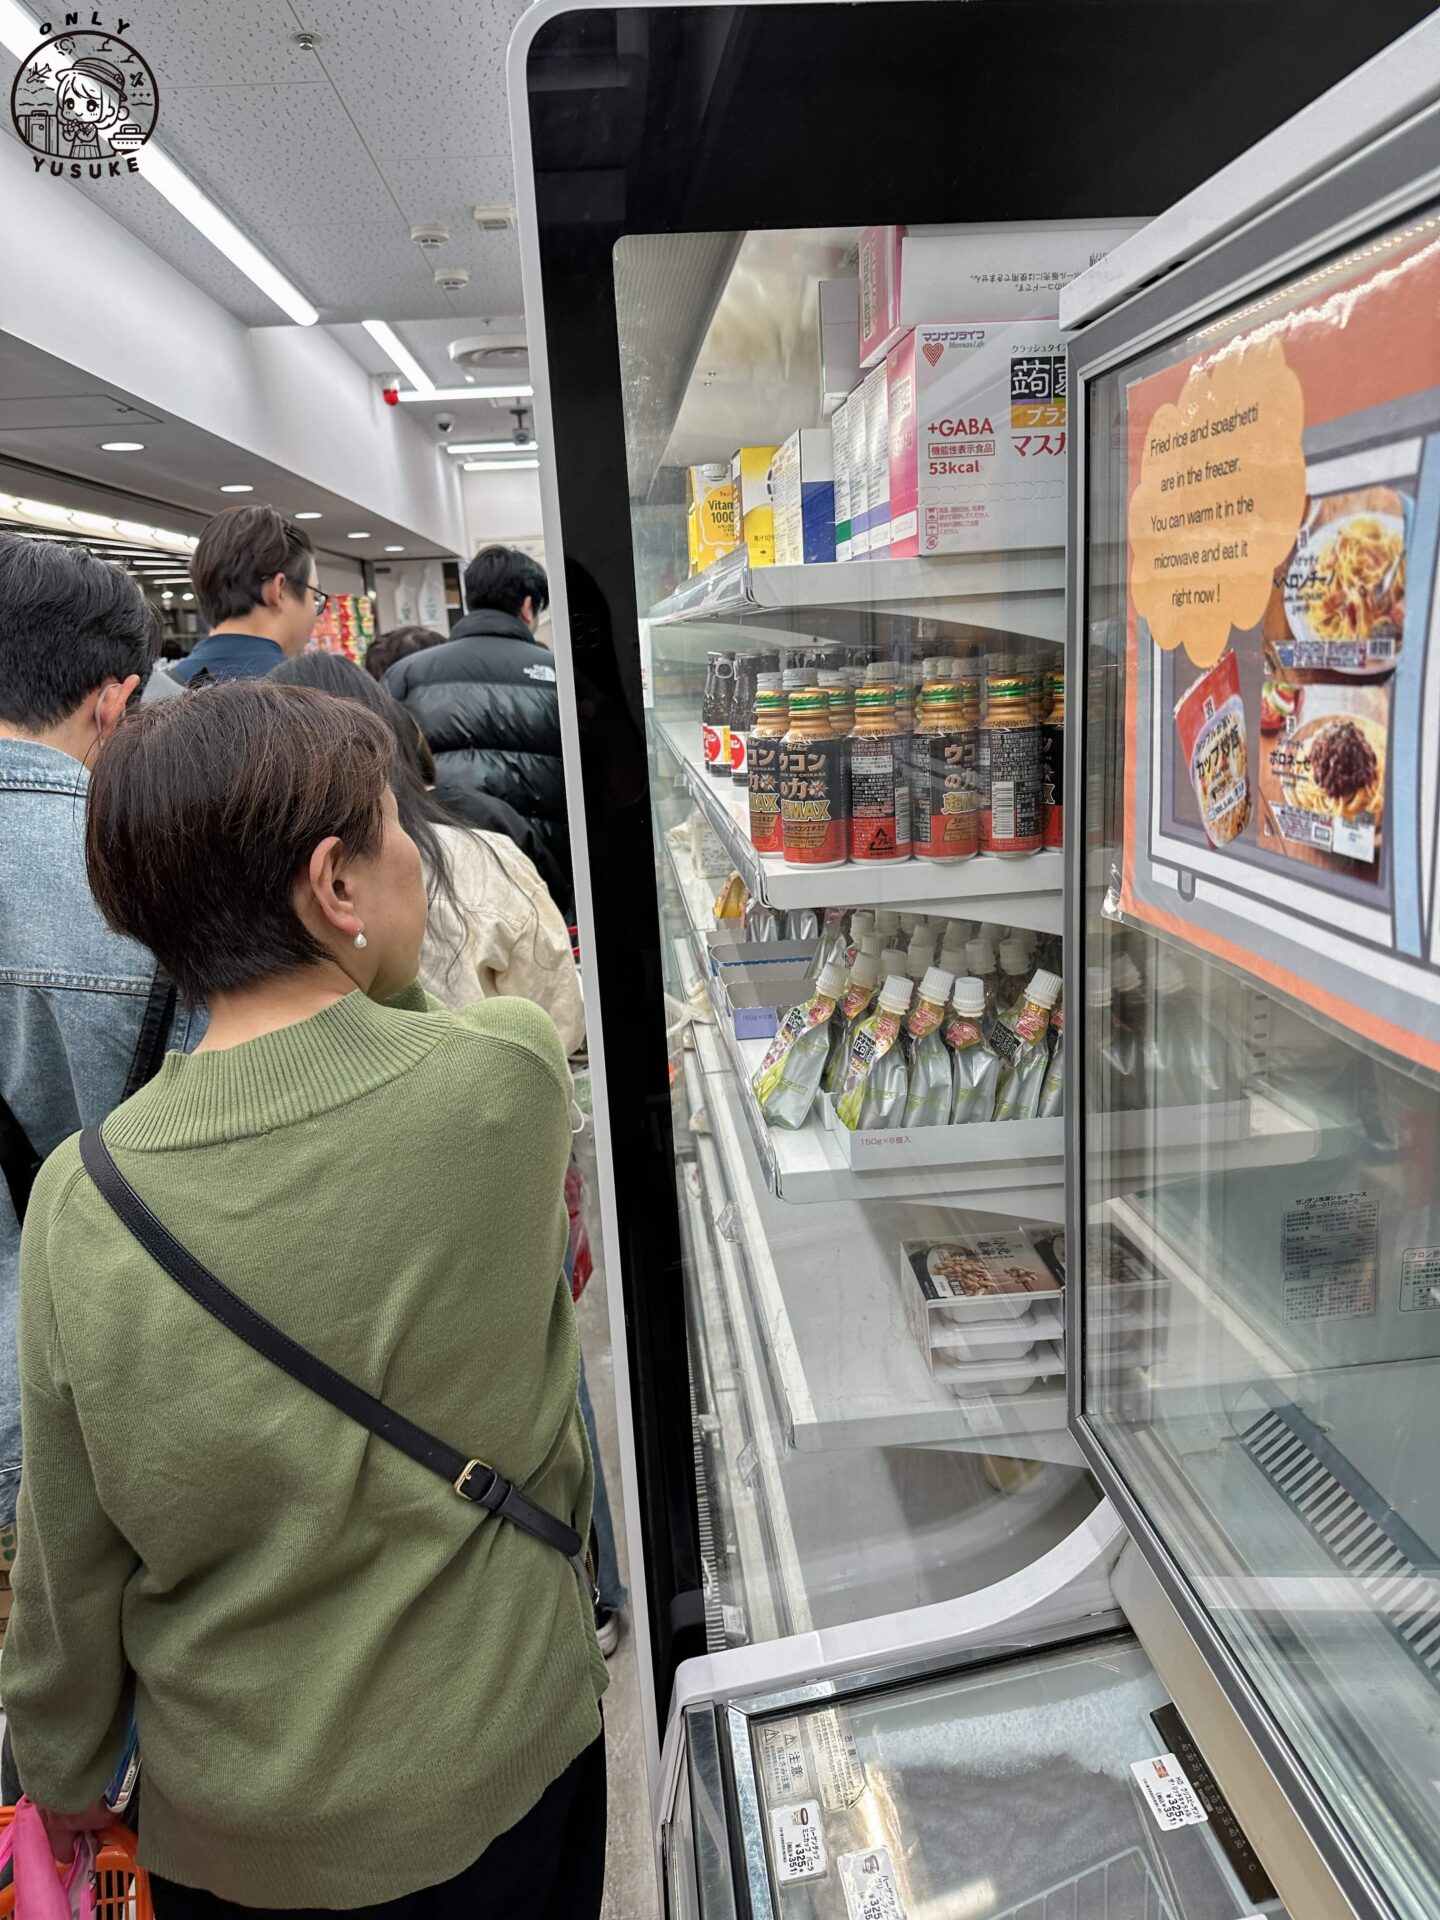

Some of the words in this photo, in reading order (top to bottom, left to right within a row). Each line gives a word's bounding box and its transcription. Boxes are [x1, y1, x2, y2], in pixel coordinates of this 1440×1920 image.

[922, 330, 985, 342] マンナンライフ
[928, 417, 994, 437] +GABA
[1150, 433, 1171, 457] Fried
[1172, 432, 1188, 450] rice
[1190, 420, 1209, 444] and
[1211, 401, 1260, 436] spaghetti
[931, 443, 993, 456] 機能性表示食品
[929, 460, 979, 475] 53kcal
[1161, 477, 1175, 492] are
[1176, 472, 1185, 488] in
[1187, 466, 1202, 485] the
[1205, 458, 1242, 480] freezer.
[1151, 515, 1167, 532] You
[1169, 513, 1185, 529] can
[1187, 507, 1213, 525] warm
[1215, 502, 1222, 519] it
[1224, 500, 1234, 518] in
[1237, 495, 1254, 515] the
[1154, 550, 1199, 570] microwave
[1201, 542, 1220, 563] and
[1222, 542, 1239, 560] eat
[1240, 540, 1248, 558] it
[1172, 587, 1192, 607] right
[1193, 589, 1215, 604] now
[788, 1751, 804, 1777] 注意
